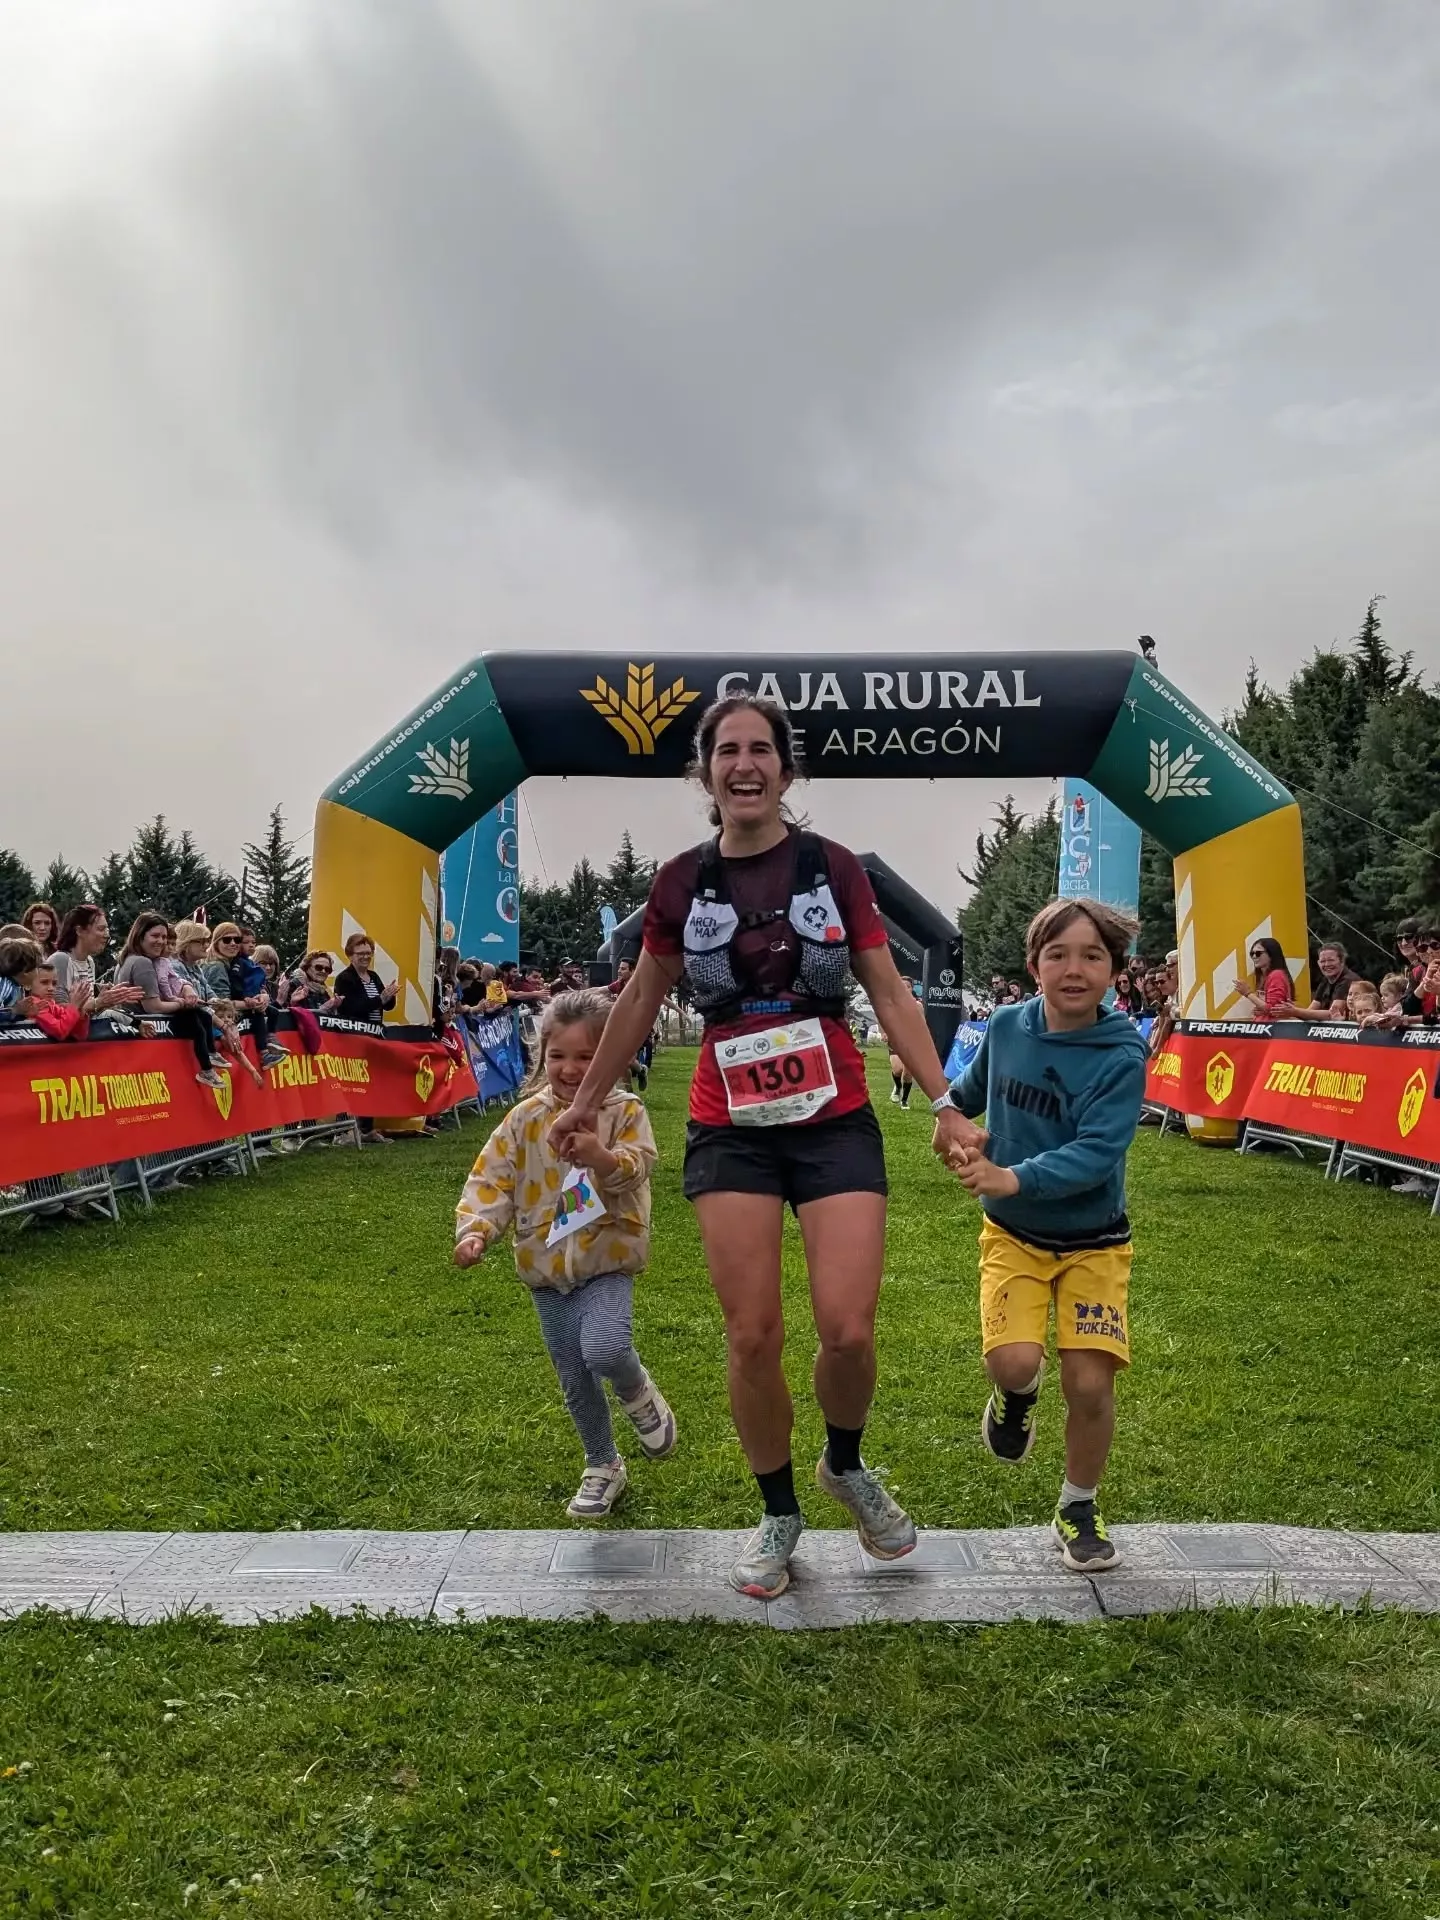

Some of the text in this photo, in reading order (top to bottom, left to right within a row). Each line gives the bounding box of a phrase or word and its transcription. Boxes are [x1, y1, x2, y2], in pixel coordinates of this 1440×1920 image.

[716, 669, 1042, 711] CAJA RURAL
[338, 670, 478, 795] cajaruraldearagon.es
[821, 718, 1001, 756] ARAGÓN
[1142, 672, 1281, 801] cajaruraldearagon.es
[694, 926, 720, 939] MAX
[900, 946, 920, 963] mejor
[319, 1016, 386, 1039] FIREHAWK
[1188, 1021, 1273, 1037] FIREHAWK
[1307, 1026, 1363, 1043] FIREHAWK
[746, 1053, 806, 1094] 130
[1263, 1061, 1368, 1103] TRAIL TORROLLONES
[30, 1071, 171, 1124] TRAIL TORROLLONES
